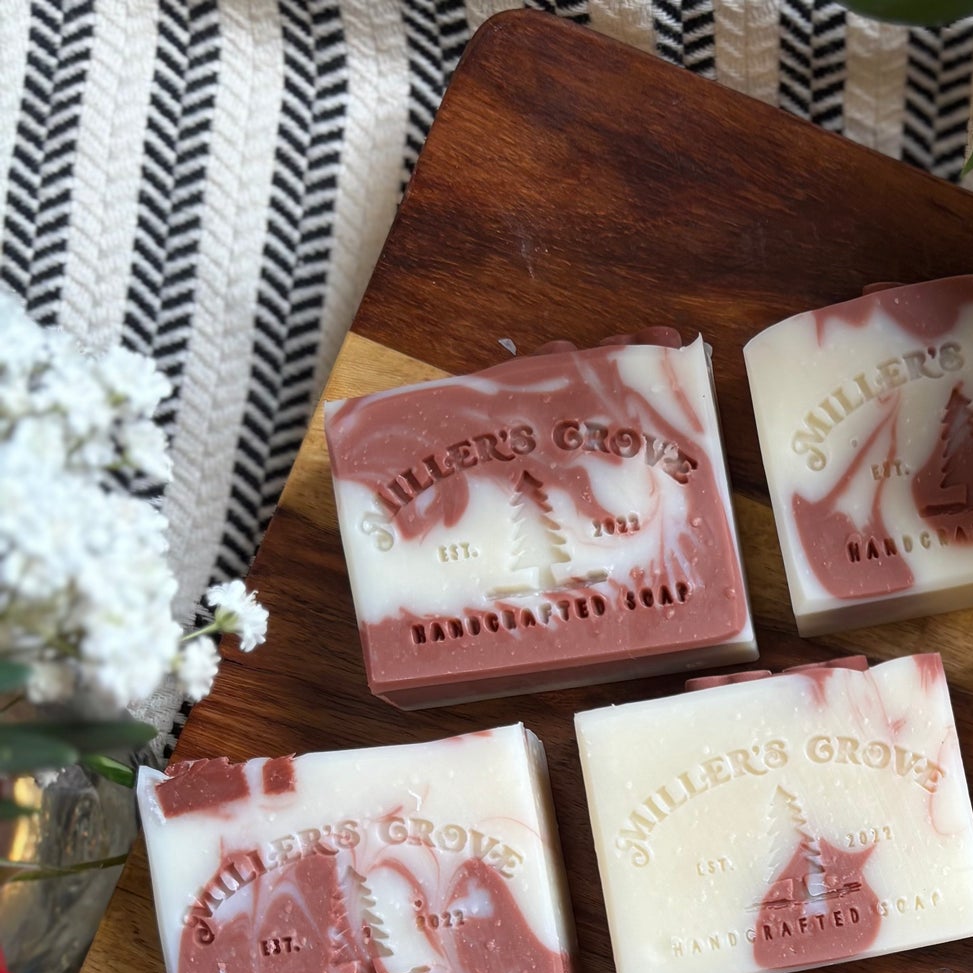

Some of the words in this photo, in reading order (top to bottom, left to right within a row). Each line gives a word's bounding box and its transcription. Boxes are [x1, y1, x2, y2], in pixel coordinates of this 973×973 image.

[791, 343, 965, 471] MILLER'S
[361, 424, 537, 552] MILLER'S
[552, 419, 698, 484] GROVE
[872, 461, 910, 480] EST.
[438, 542, 479, 562] EST.
[411, 595, 606, 644] HANDCRAFTED
[625, 582, 692, 610] SOAP
[616, 740, 788, 868] MILLER'S
[806, 736, 945, 793] GROVE
[847, 826, 893, 847] 2022
[183, 820, 360, 946] MILLER'S
[378, 818, 523, 878] GROVE
[261, 937, 301, 956] EST.
[417, 911, 465, 930] 2022
[672, 908, 860, 957] HANDCRAFTED
[878, 894, 941, 916] SOAP
